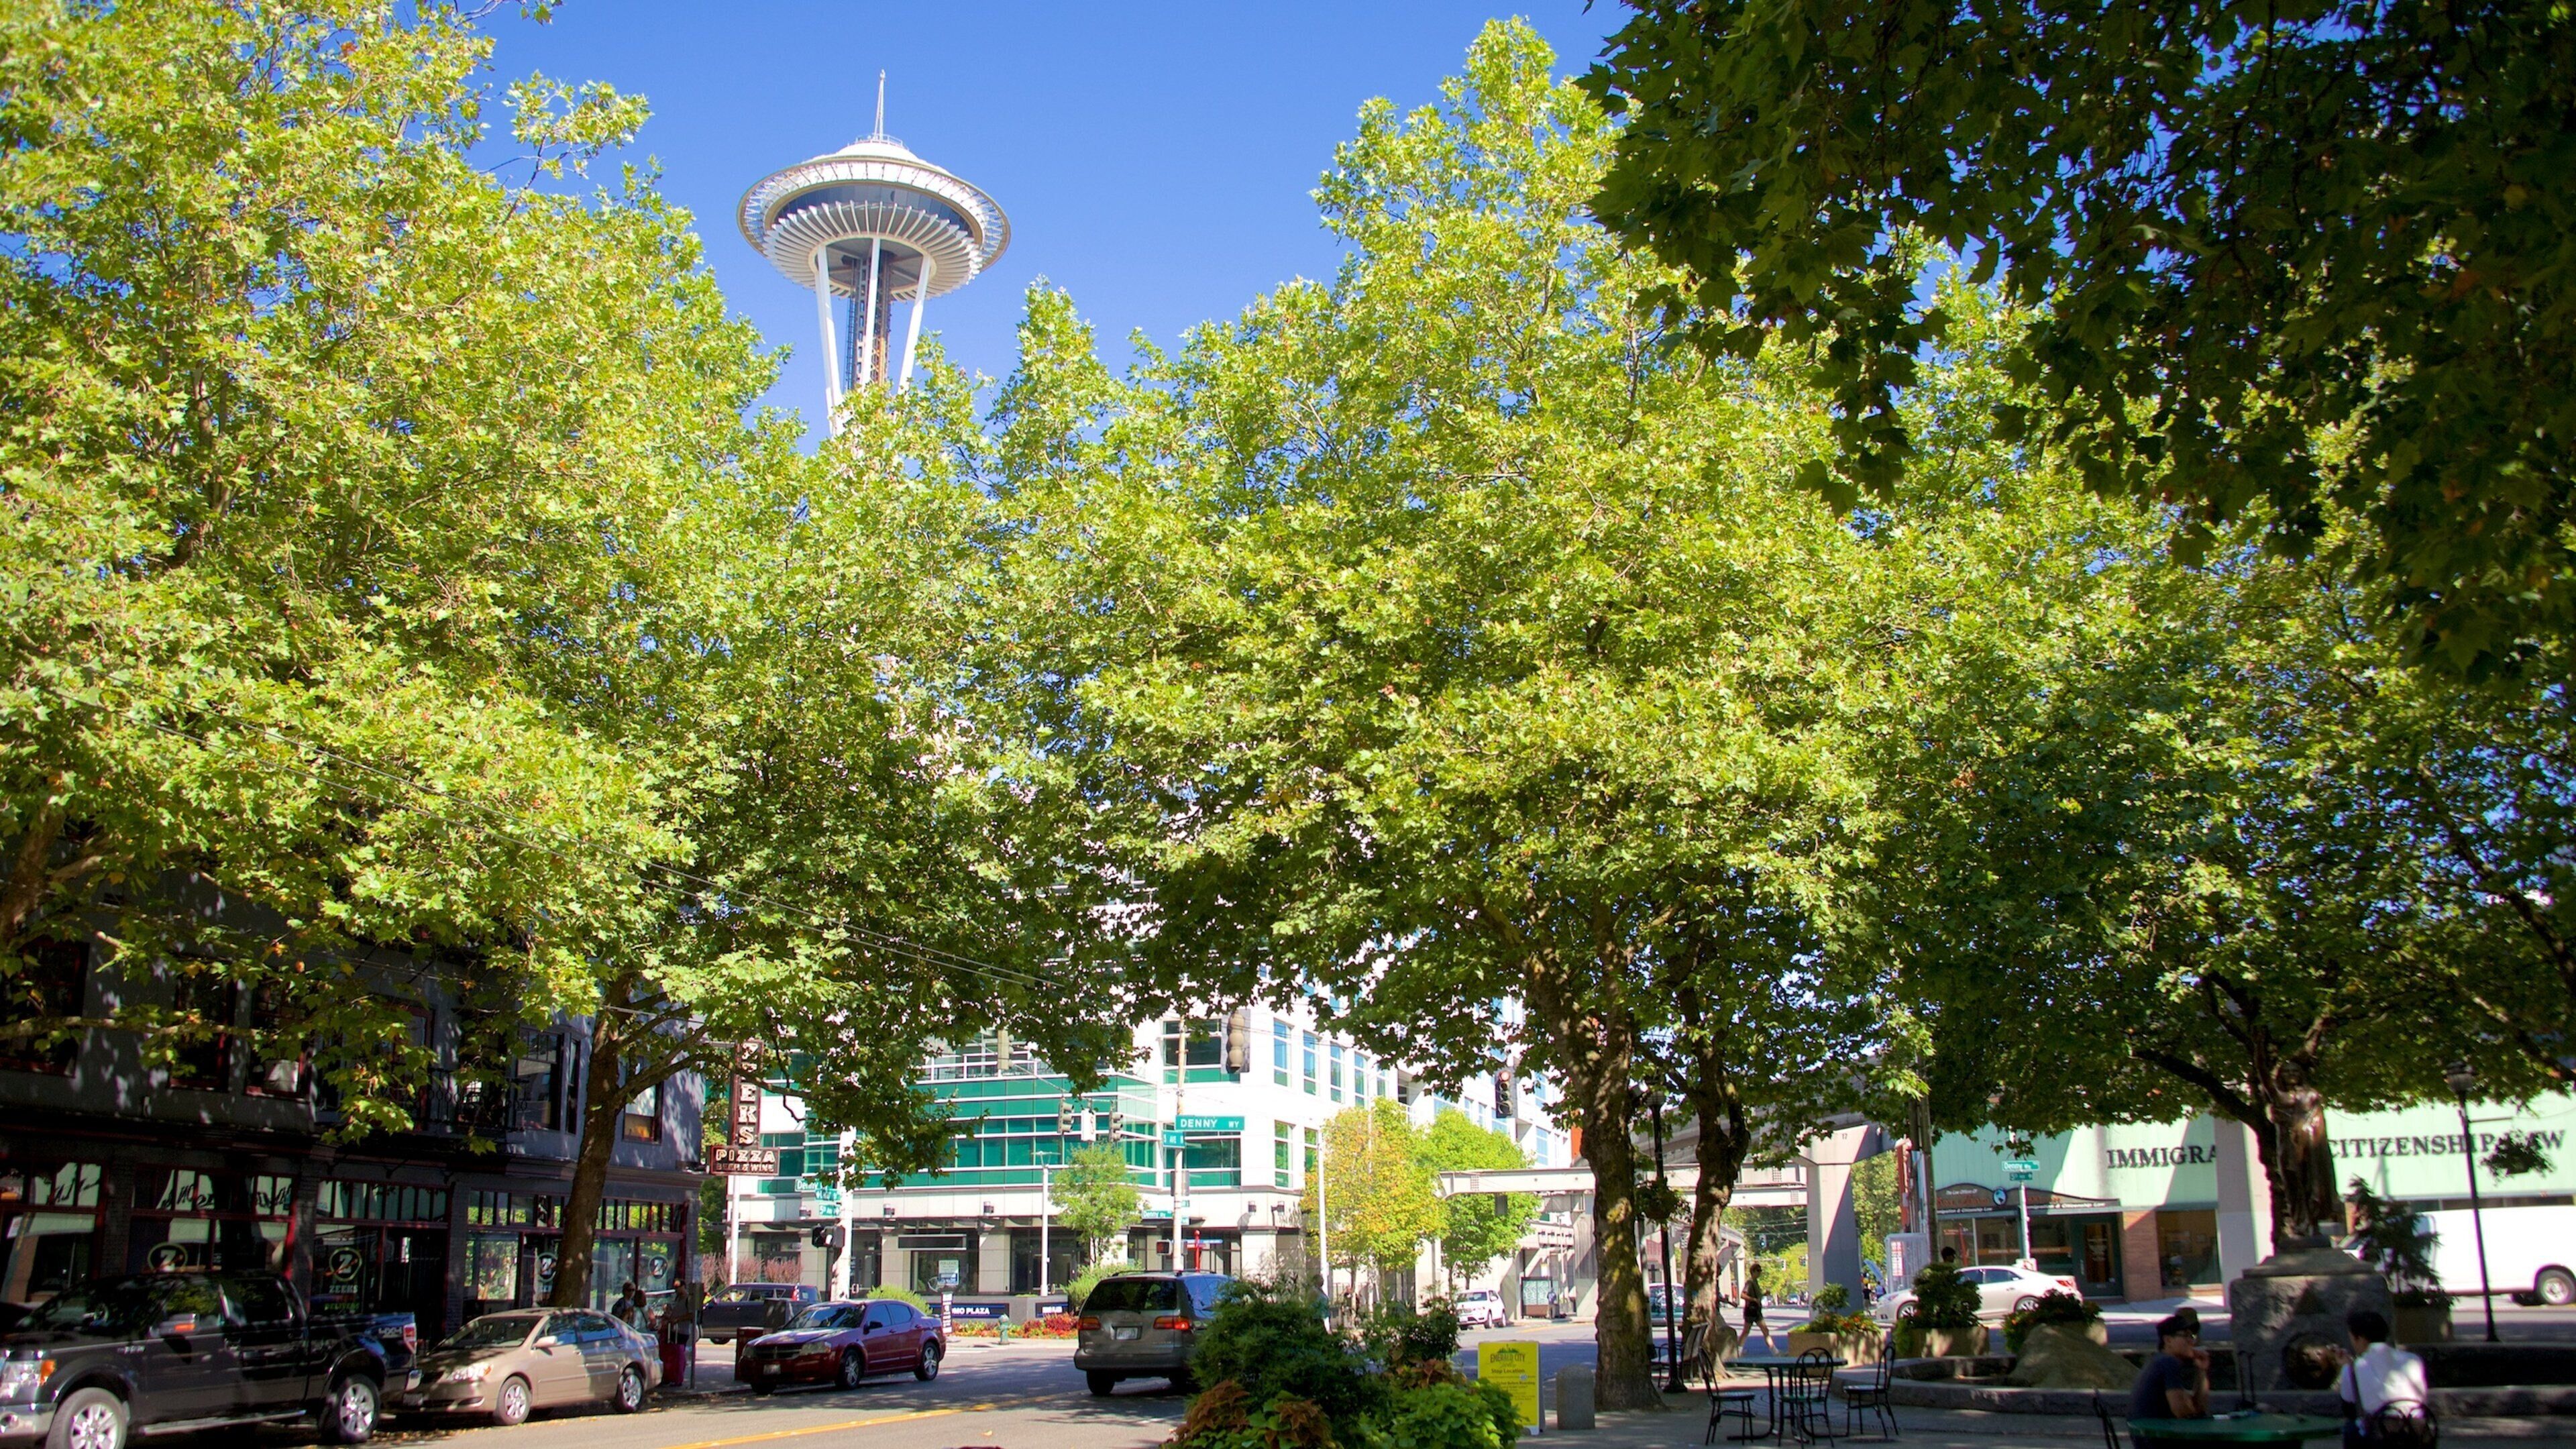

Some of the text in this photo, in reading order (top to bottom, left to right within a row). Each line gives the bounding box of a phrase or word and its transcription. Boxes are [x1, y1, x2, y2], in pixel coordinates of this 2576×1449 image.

[1180, 1119, 1218, 1128] DENNY
[716, 1149, 775, 1163] PIZZA
[2106, 1144, 2216, 1169] IMMIGRA
[751, 1163, 774, 1171] WINE
[2004, 1162, 2023, 1171] Denny
[338, 1254, 353, 1274] Z
[329, 1285, 358, 1293] ZEEKS
[1490, 1354, 1525, 1363] EMERALD CITY
